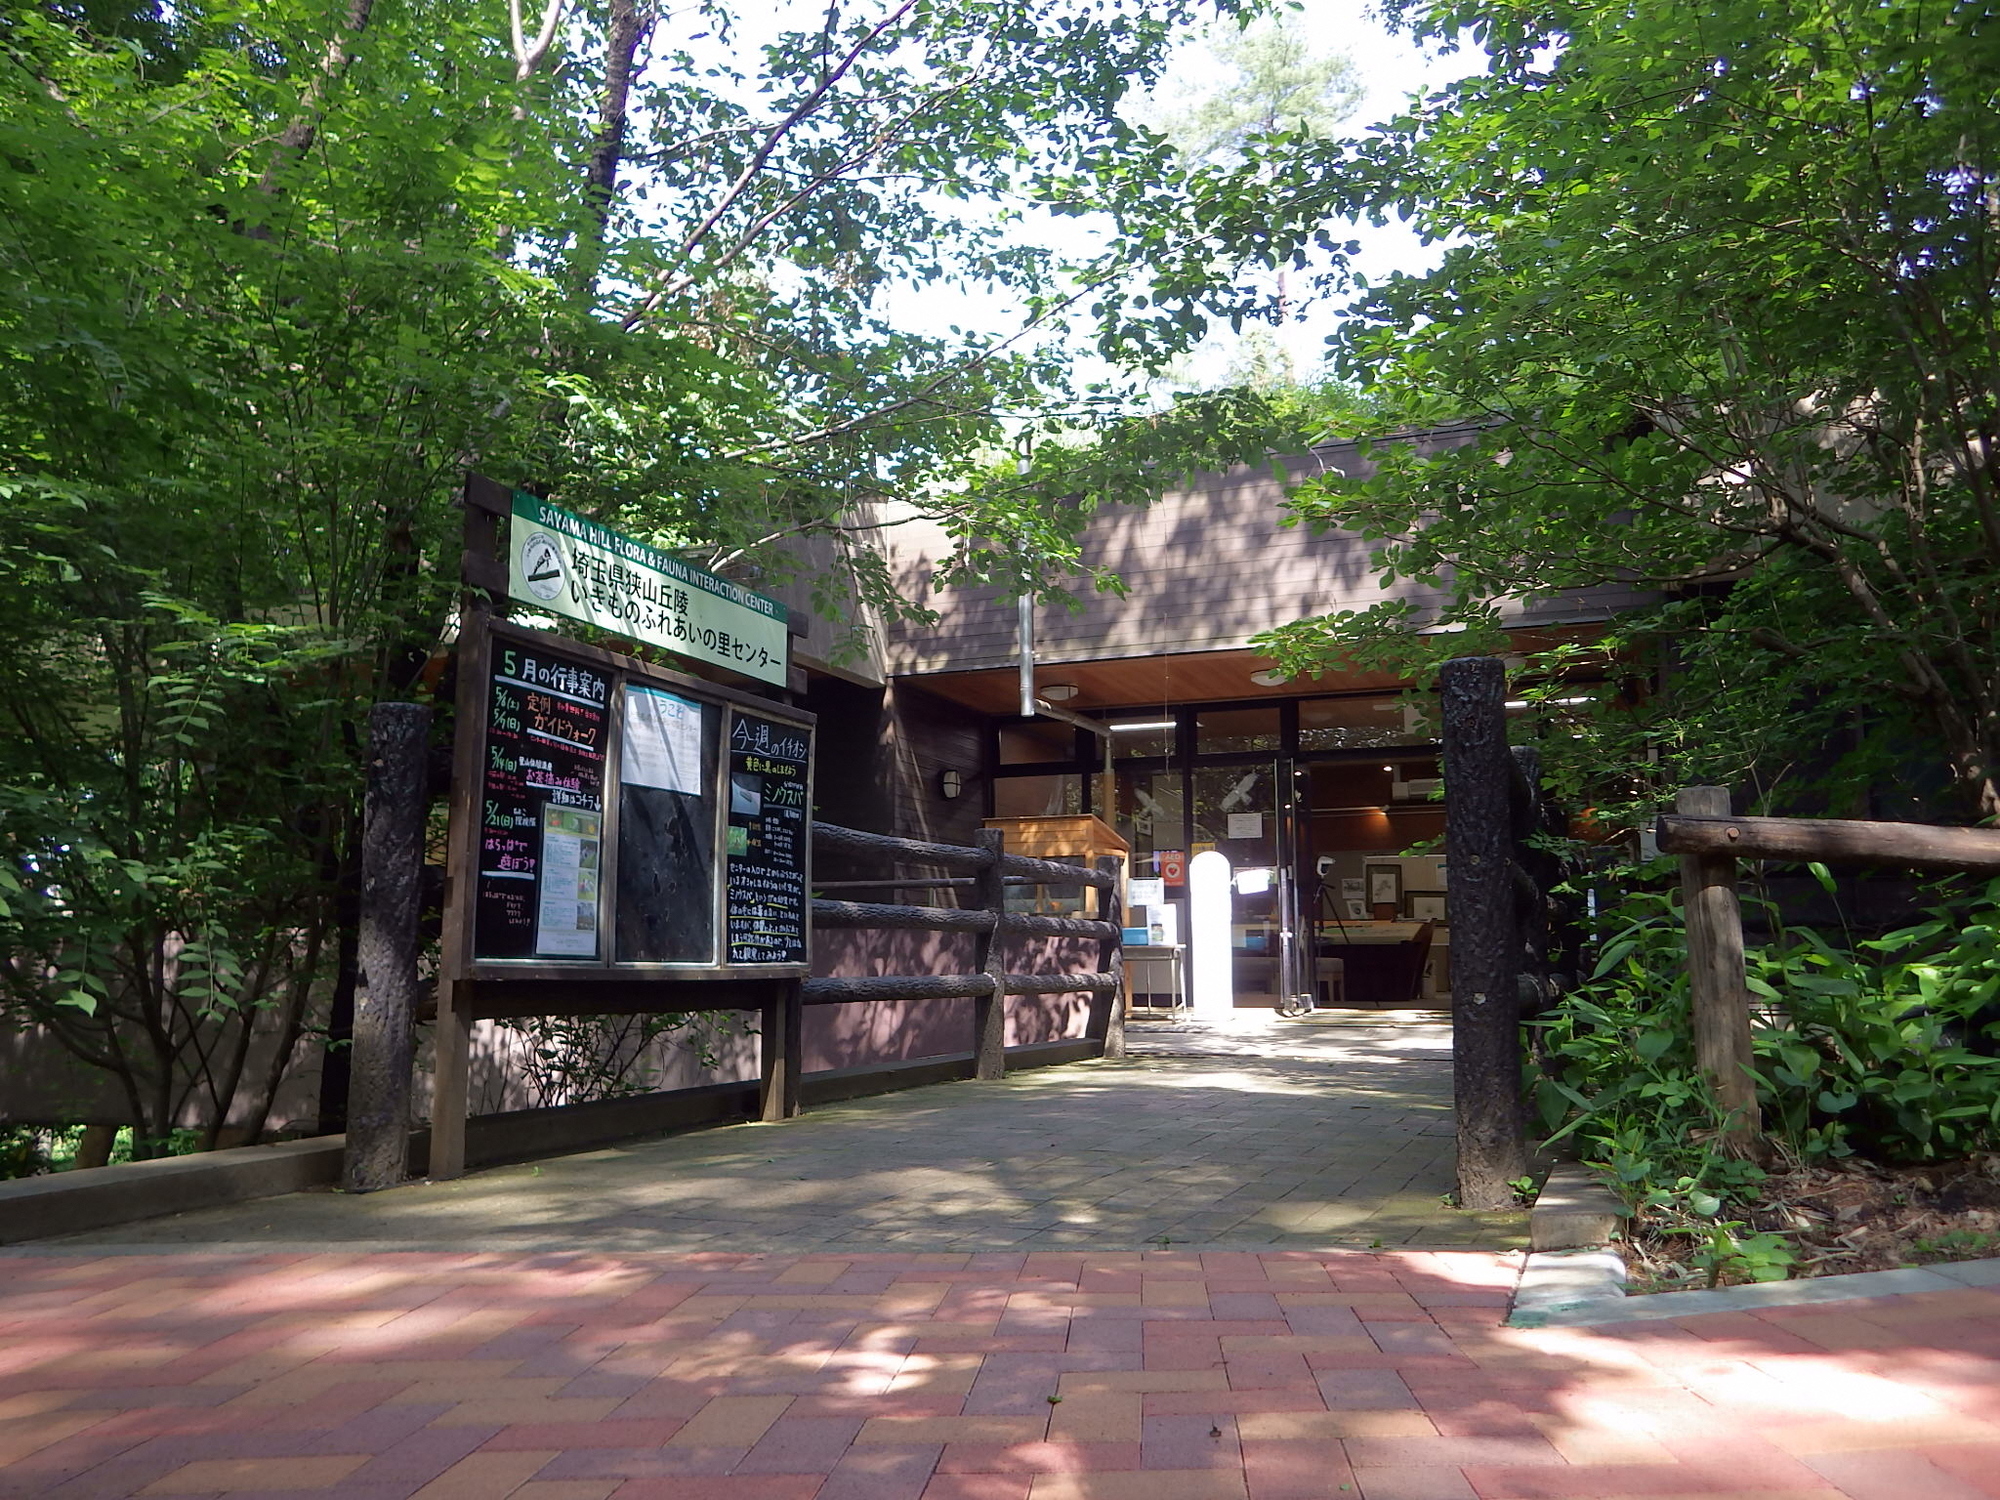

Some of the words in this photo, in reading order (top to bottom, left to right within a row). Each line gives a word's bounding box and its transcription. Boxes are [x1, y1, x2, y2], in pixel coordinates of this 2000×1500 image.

[539, 506, 587, 540] SAYAMA
[589, 526, 612, 550] HILL
[614, 536, 646, 565] FLORA
[647, 551, 656, 567] &
[657, 555, 688, 581] FAUNA
[689, 569, 744, 604] INTERACTION
[744, 593, 774, 616] CENTER
[571, 548, 689, 617] 埼玉県狭山丘陵
[571, 580, 782, 668] いきものふれあいの里センター
[534, 712, 597, 745] ガイドウォーク
[1165, 853, 1181, 861] AED
